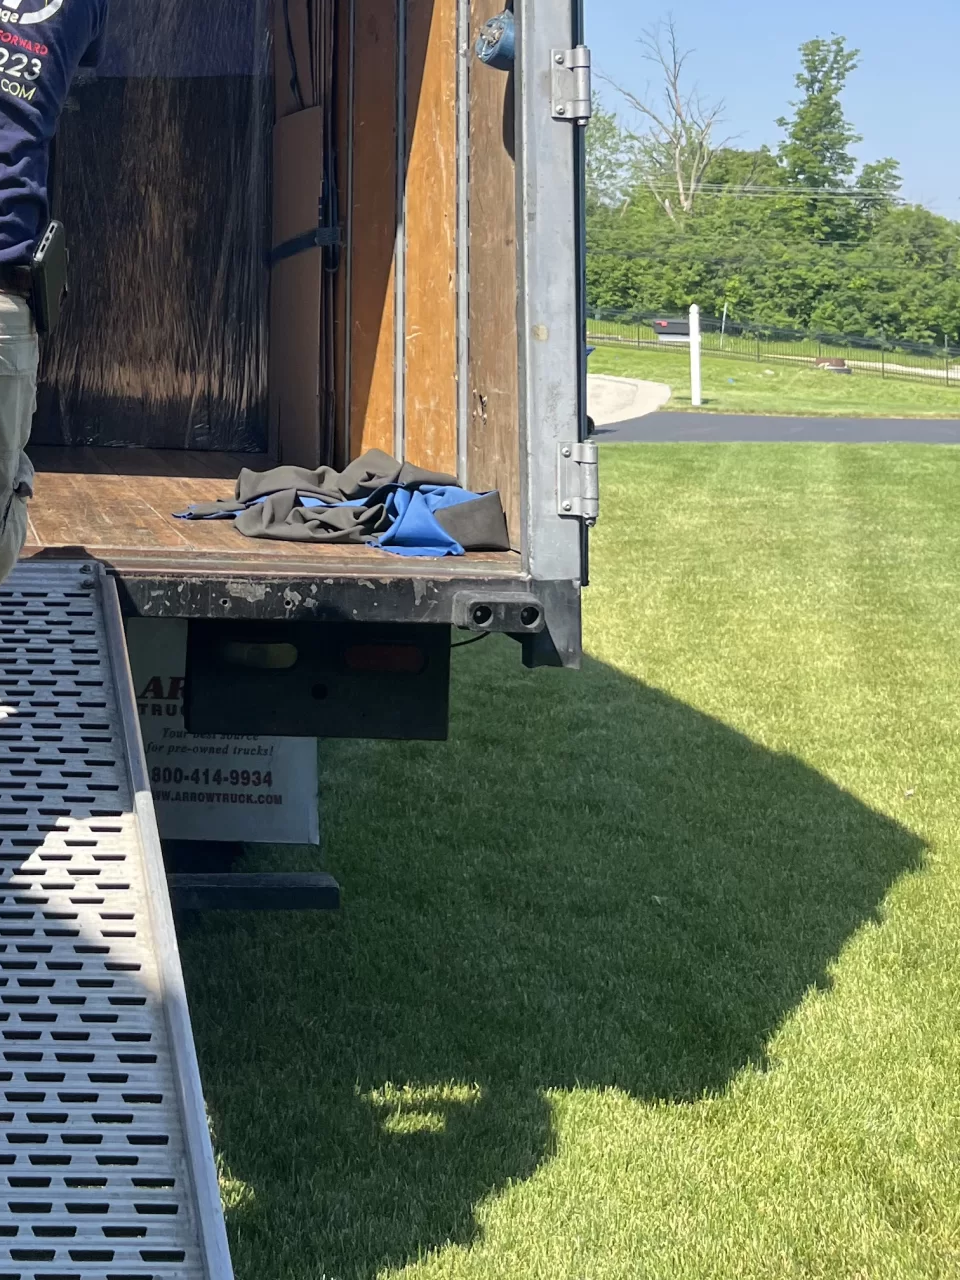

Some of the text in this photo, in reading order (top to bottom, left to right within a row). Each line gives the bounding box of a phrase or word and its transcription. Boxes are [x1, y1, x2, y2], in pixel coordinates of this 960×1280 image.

[137, 703, 185, 717] TRU
[146, 741, 274, 757] for pre-owned trucks!
[151, 766, 274, 788] 800-414-9934
